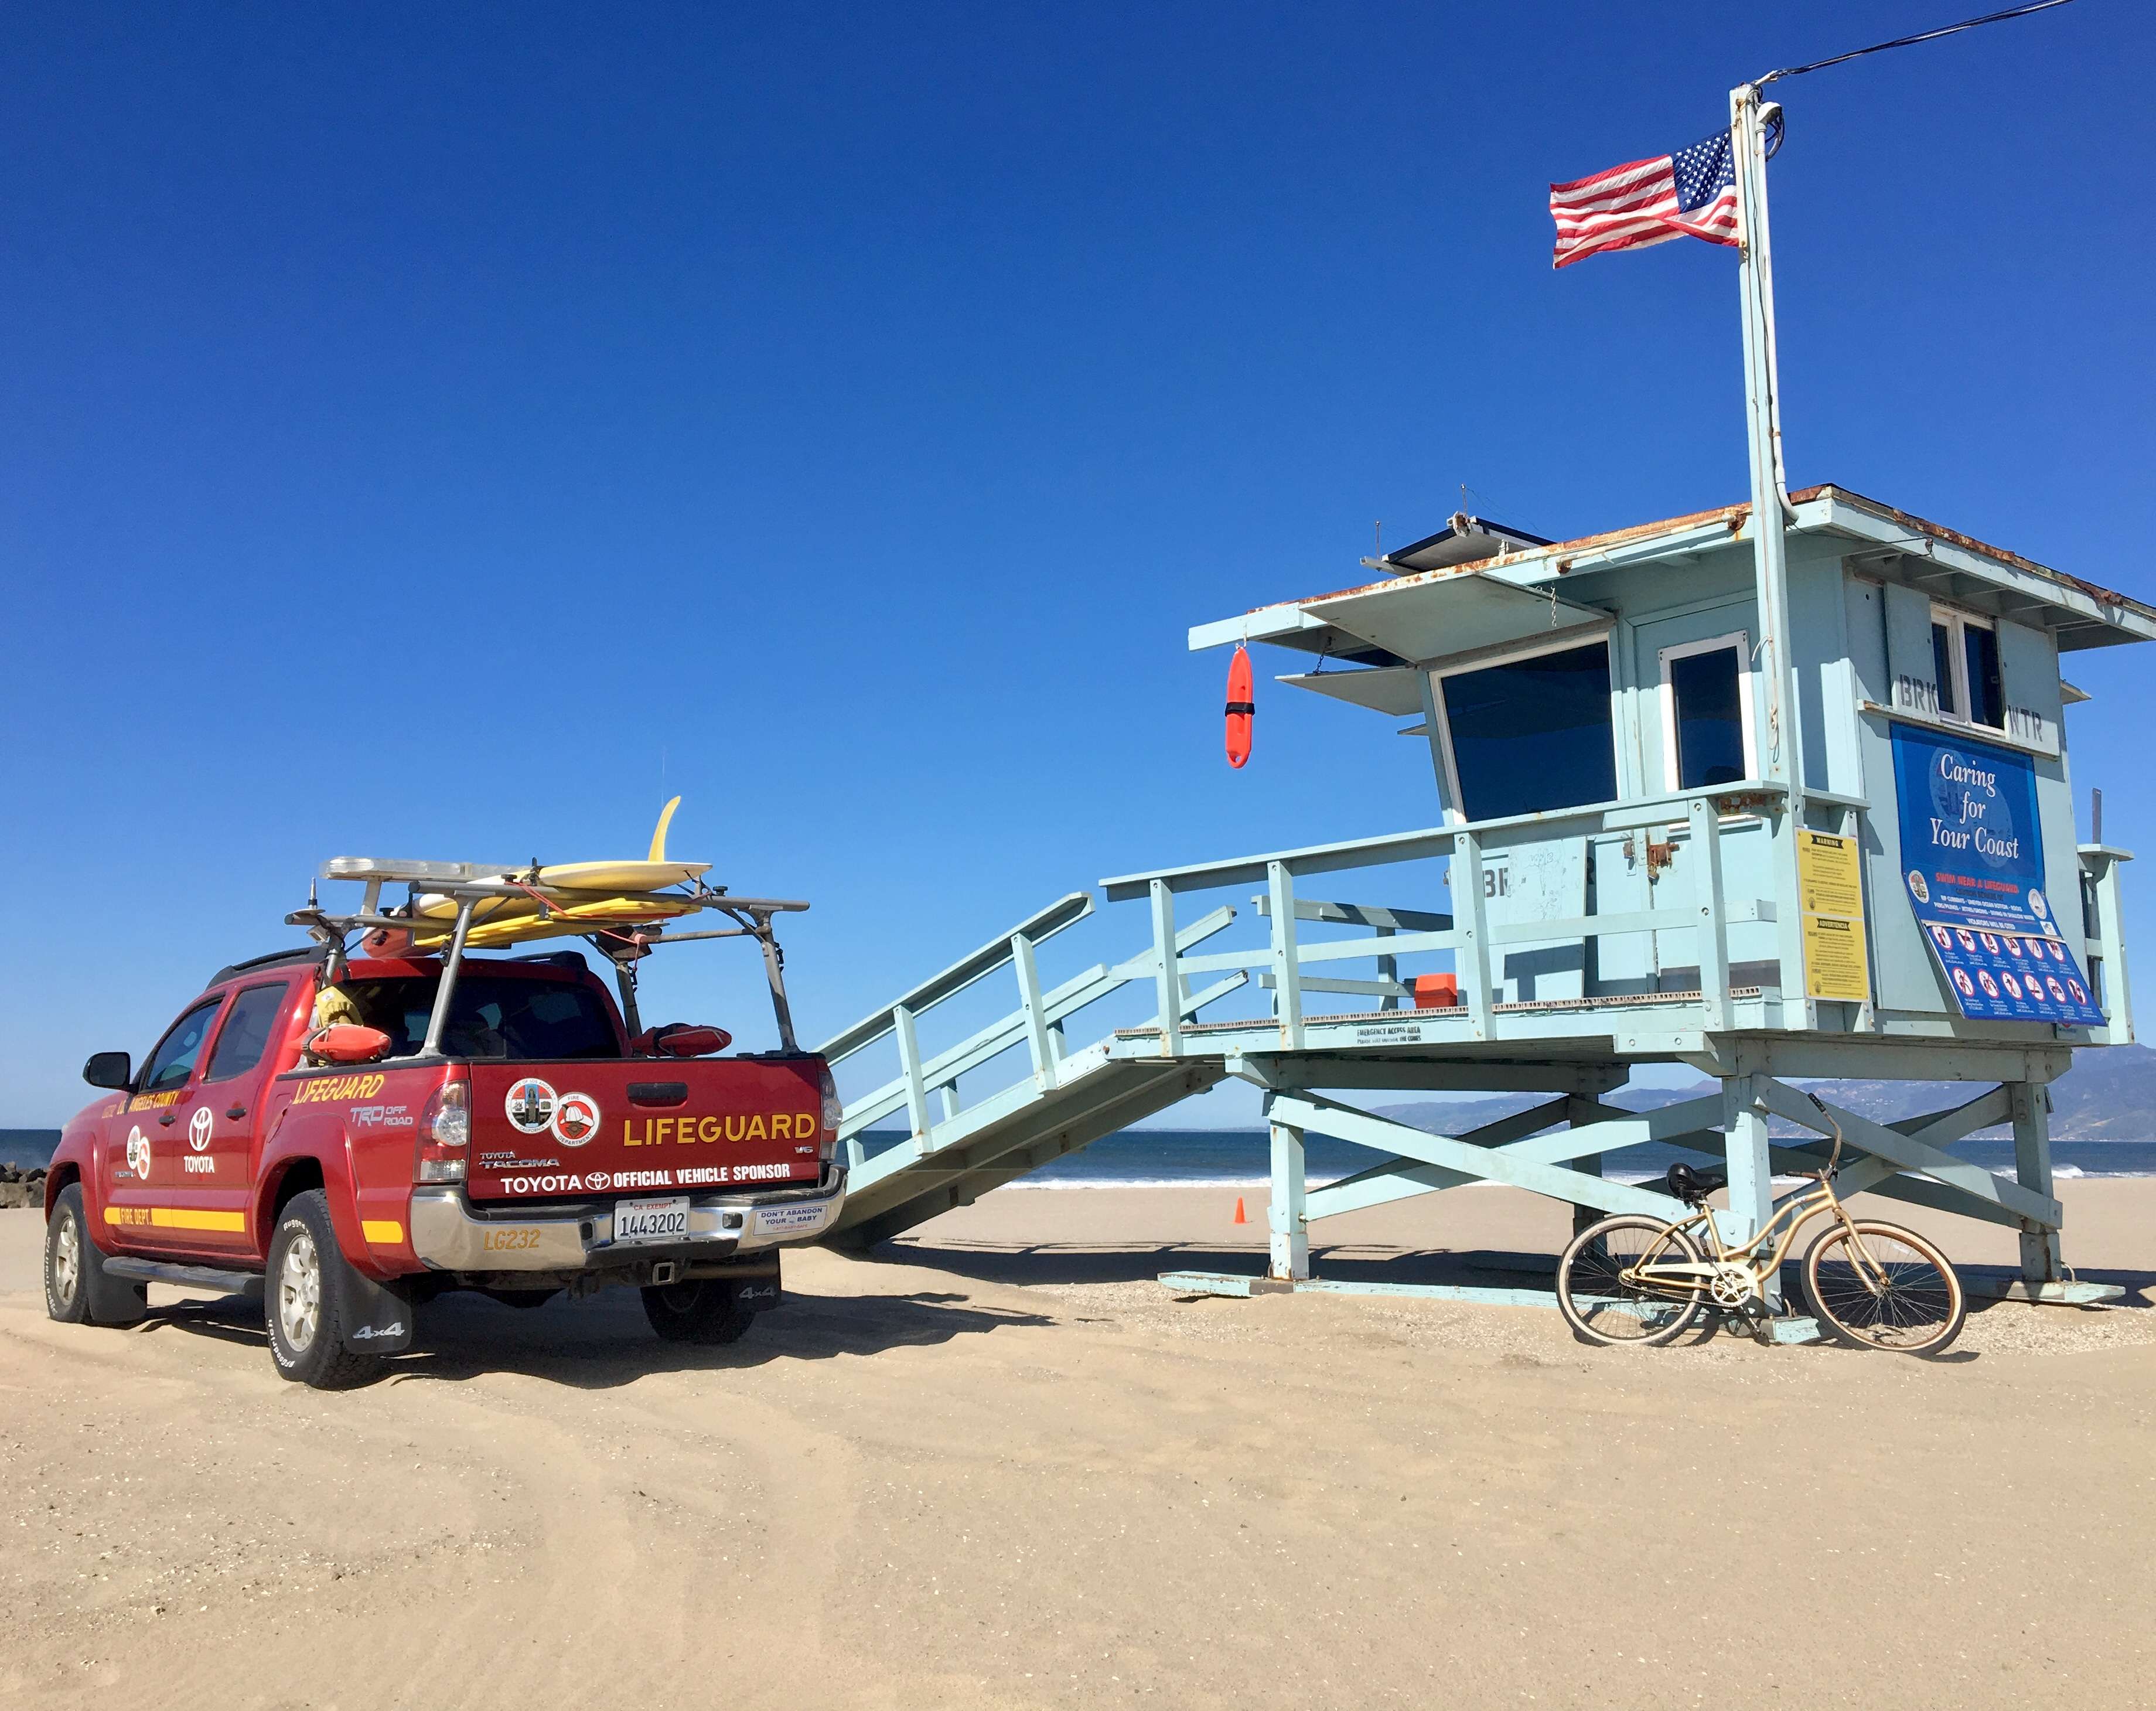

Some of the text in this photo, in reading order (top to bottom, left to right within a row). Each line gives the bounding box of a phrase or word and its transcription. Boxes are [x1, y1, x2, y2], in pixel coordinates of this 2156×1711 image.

[1899, 674, 2042, 741] BRK WTR
[1940, 754, 1995, 797] Caring
[1960, 791, 1986, 824] for
[1816, 837, 1838, 846] WARNING
[1930, 818, 2018, 858] Your Coast
[1935, 872, 1955, 884] SWIM
[1984, 880, 2019, 894] LIFEGUARD
[1819, 921, 1847, 929] ADVERTENCIA
[1357, 1028, 1386, 1036] EMERGENCY
[292, 1074, 384, 1105] LIFEGUARD
[509, 1082, 521, 1096] COUNTY
[539, 1081, 555, 1096] ANGELES
[153, 1090, 180, 1109] COUNTY
[350, 1106, 384, 1127] TRD
[386, 1106, 407, 1114] OFF
[383, 1116, 412, 1125] ROAD
[519, 1125, 545, 1133] CALIFORNIA
[623, 1113, 816, 1146] LIFEGUARD
[558, 1133, 593, 1146] DEPARTMENT
[479, 1158, 560, 1169] TACOMA
[480, 1151, 516, 1159] TOYOTA
[183, 1156, 215, 1173] TOYOTA
[500, 1163, 790, 1194] TOYOTA OFFICIAL VEHICLE SPONSOR
[646, 1202, 672, 1210] EXEMPT
[786, 1207, 823, 1215] ABANDON
[121, 1208, 152, 1225] FIRE DEPT.
[284, 1219, 306, 1231] Rugged
[620, 1212, 685, 1236] 1443202
[483, 1229, 541, 1250] LG232
[739, 1287, 776, 1298] 4x4
[353, 1322, 405, 1339] 4x4
[268, 1319, 295, 1368] BFGoodrich
